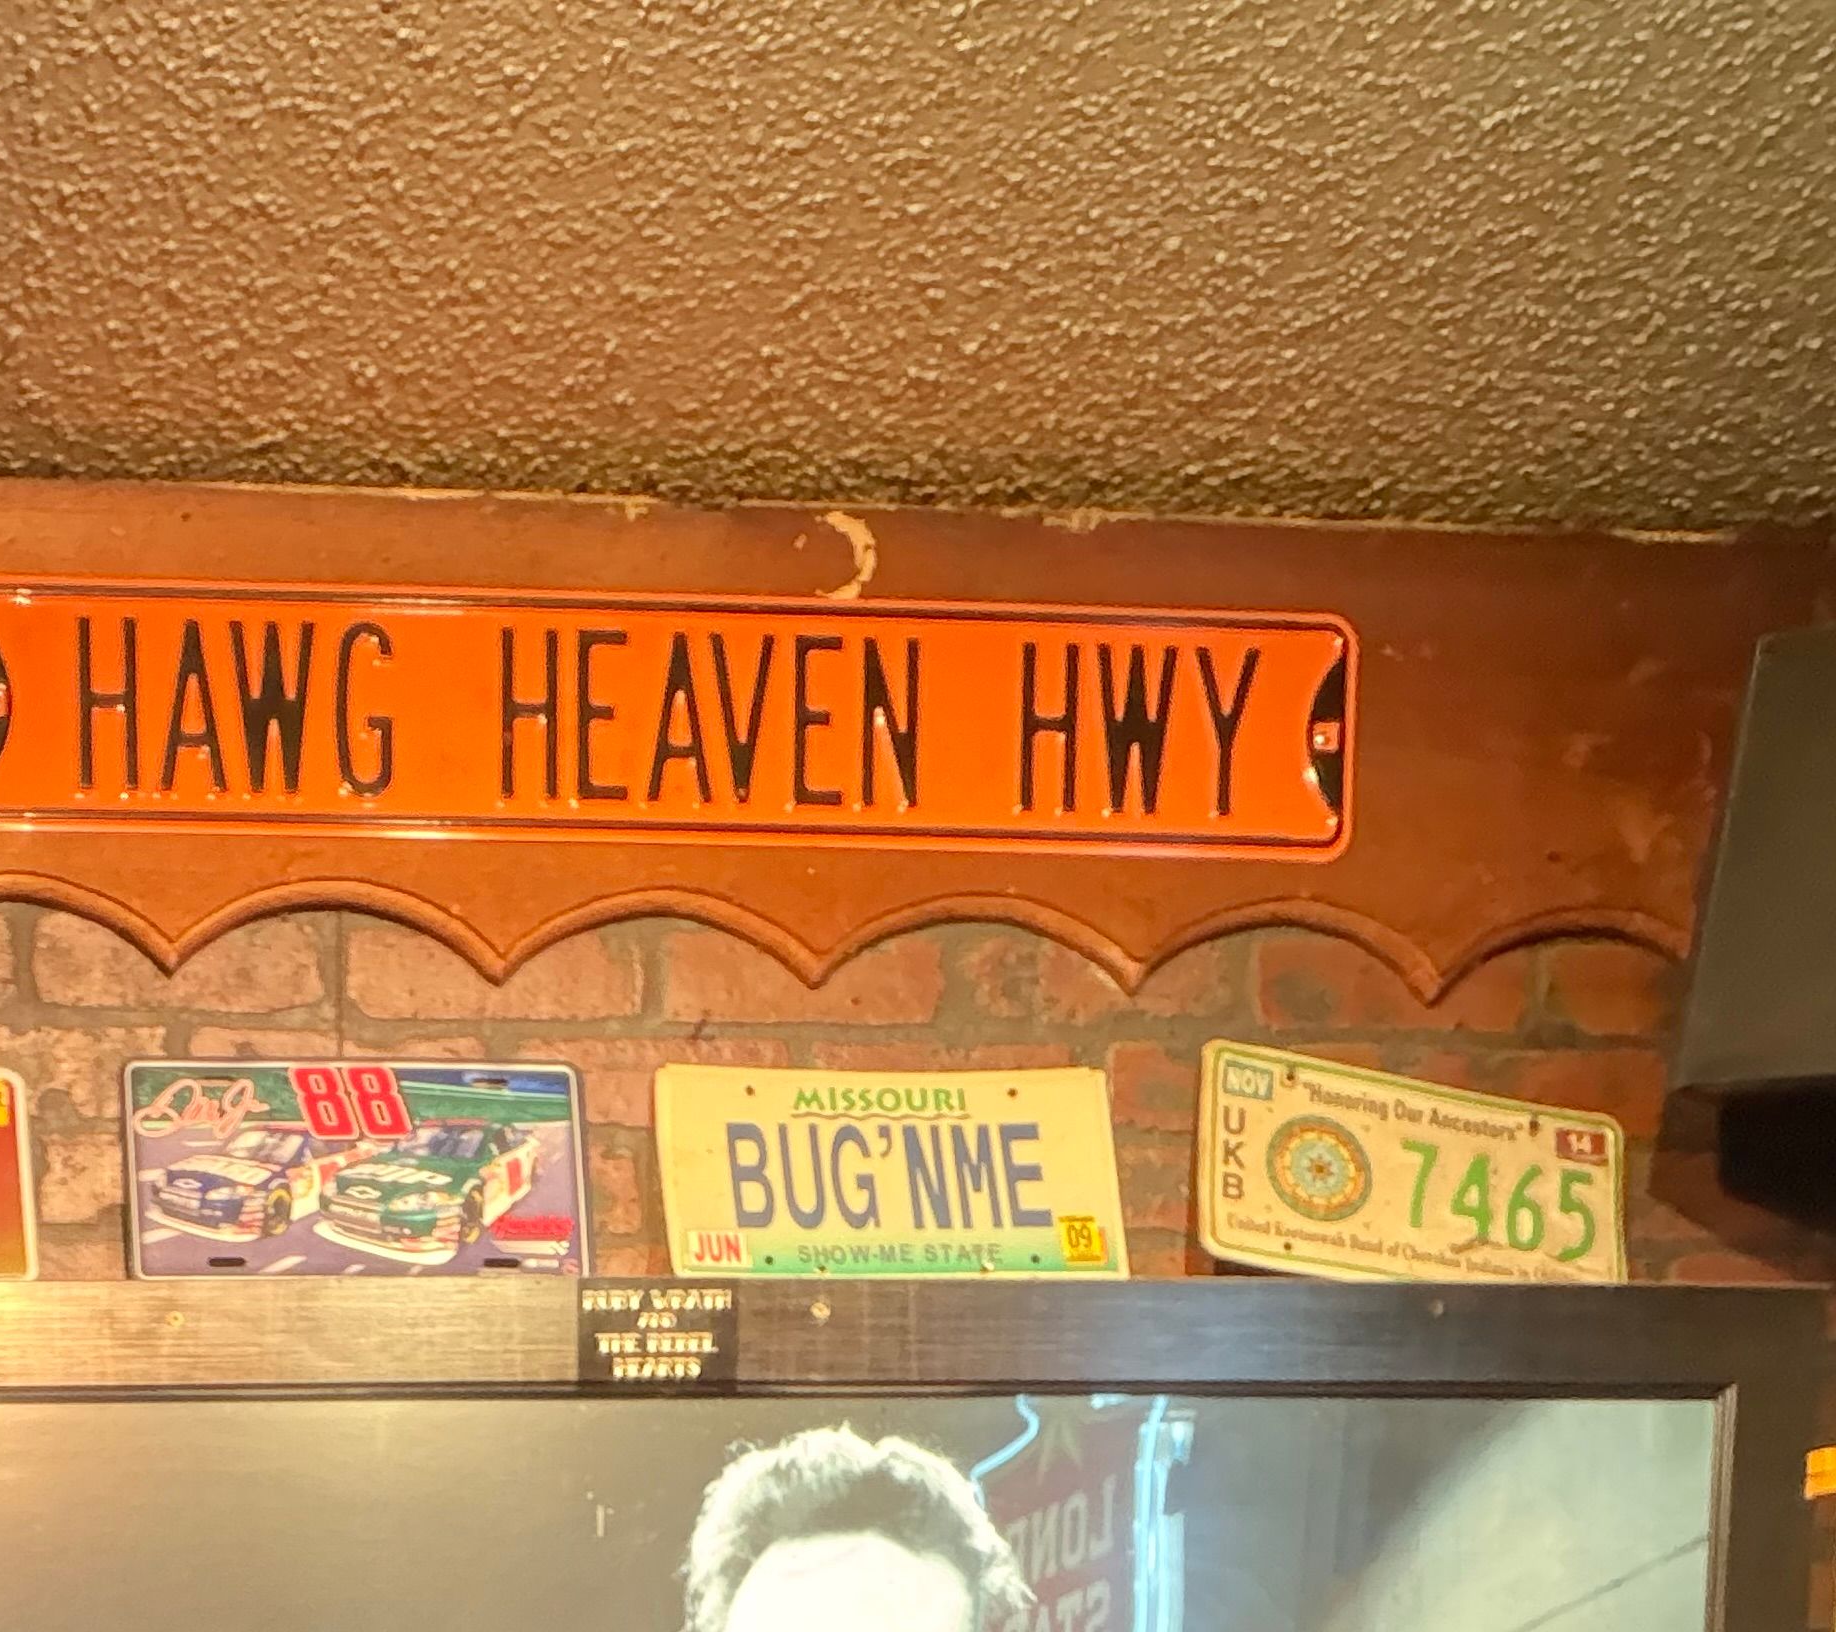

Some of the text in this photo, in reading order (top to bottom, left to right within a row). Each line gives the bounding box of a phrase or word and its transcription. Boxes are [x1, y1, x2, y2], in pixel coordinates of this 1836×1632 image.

[75, 617, 1262, 820] HAWG HEAVEN HWY
[288, 1065, 414, 1141] 88
[793, 1085, 967, 1113] MISSOURI
[1226, 1063, 1271, 1098] NOV
[725, 1121, 1053, 1231] BUG'NME
[1400, 1139, 1595, 1261] 7465
[693, 1232, 743, 1264] JUN
[797, 1241, 1004, 1265] SHOW-ME STATE
